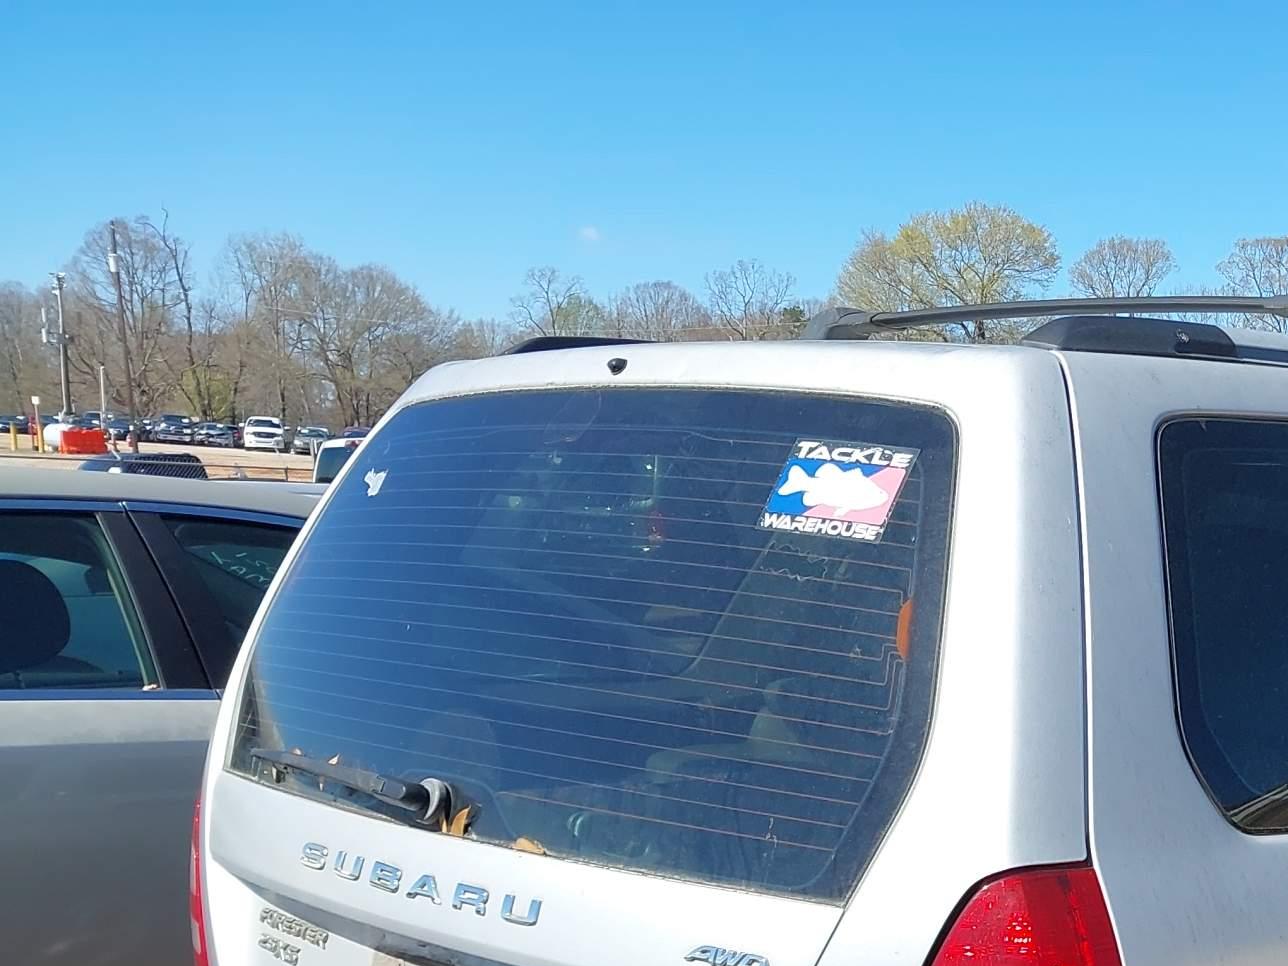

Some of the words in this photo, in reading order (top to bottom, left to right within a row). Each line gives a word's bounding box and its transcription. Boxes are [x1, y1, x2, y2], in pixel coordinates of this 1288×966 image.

[797, 441, 914, 468] TACKLE
[762, 512, 882, 541] WAREHOUSE
[300, 842, 543, 927] SUBARU
[260, 908, 329, 950] FORESTER
